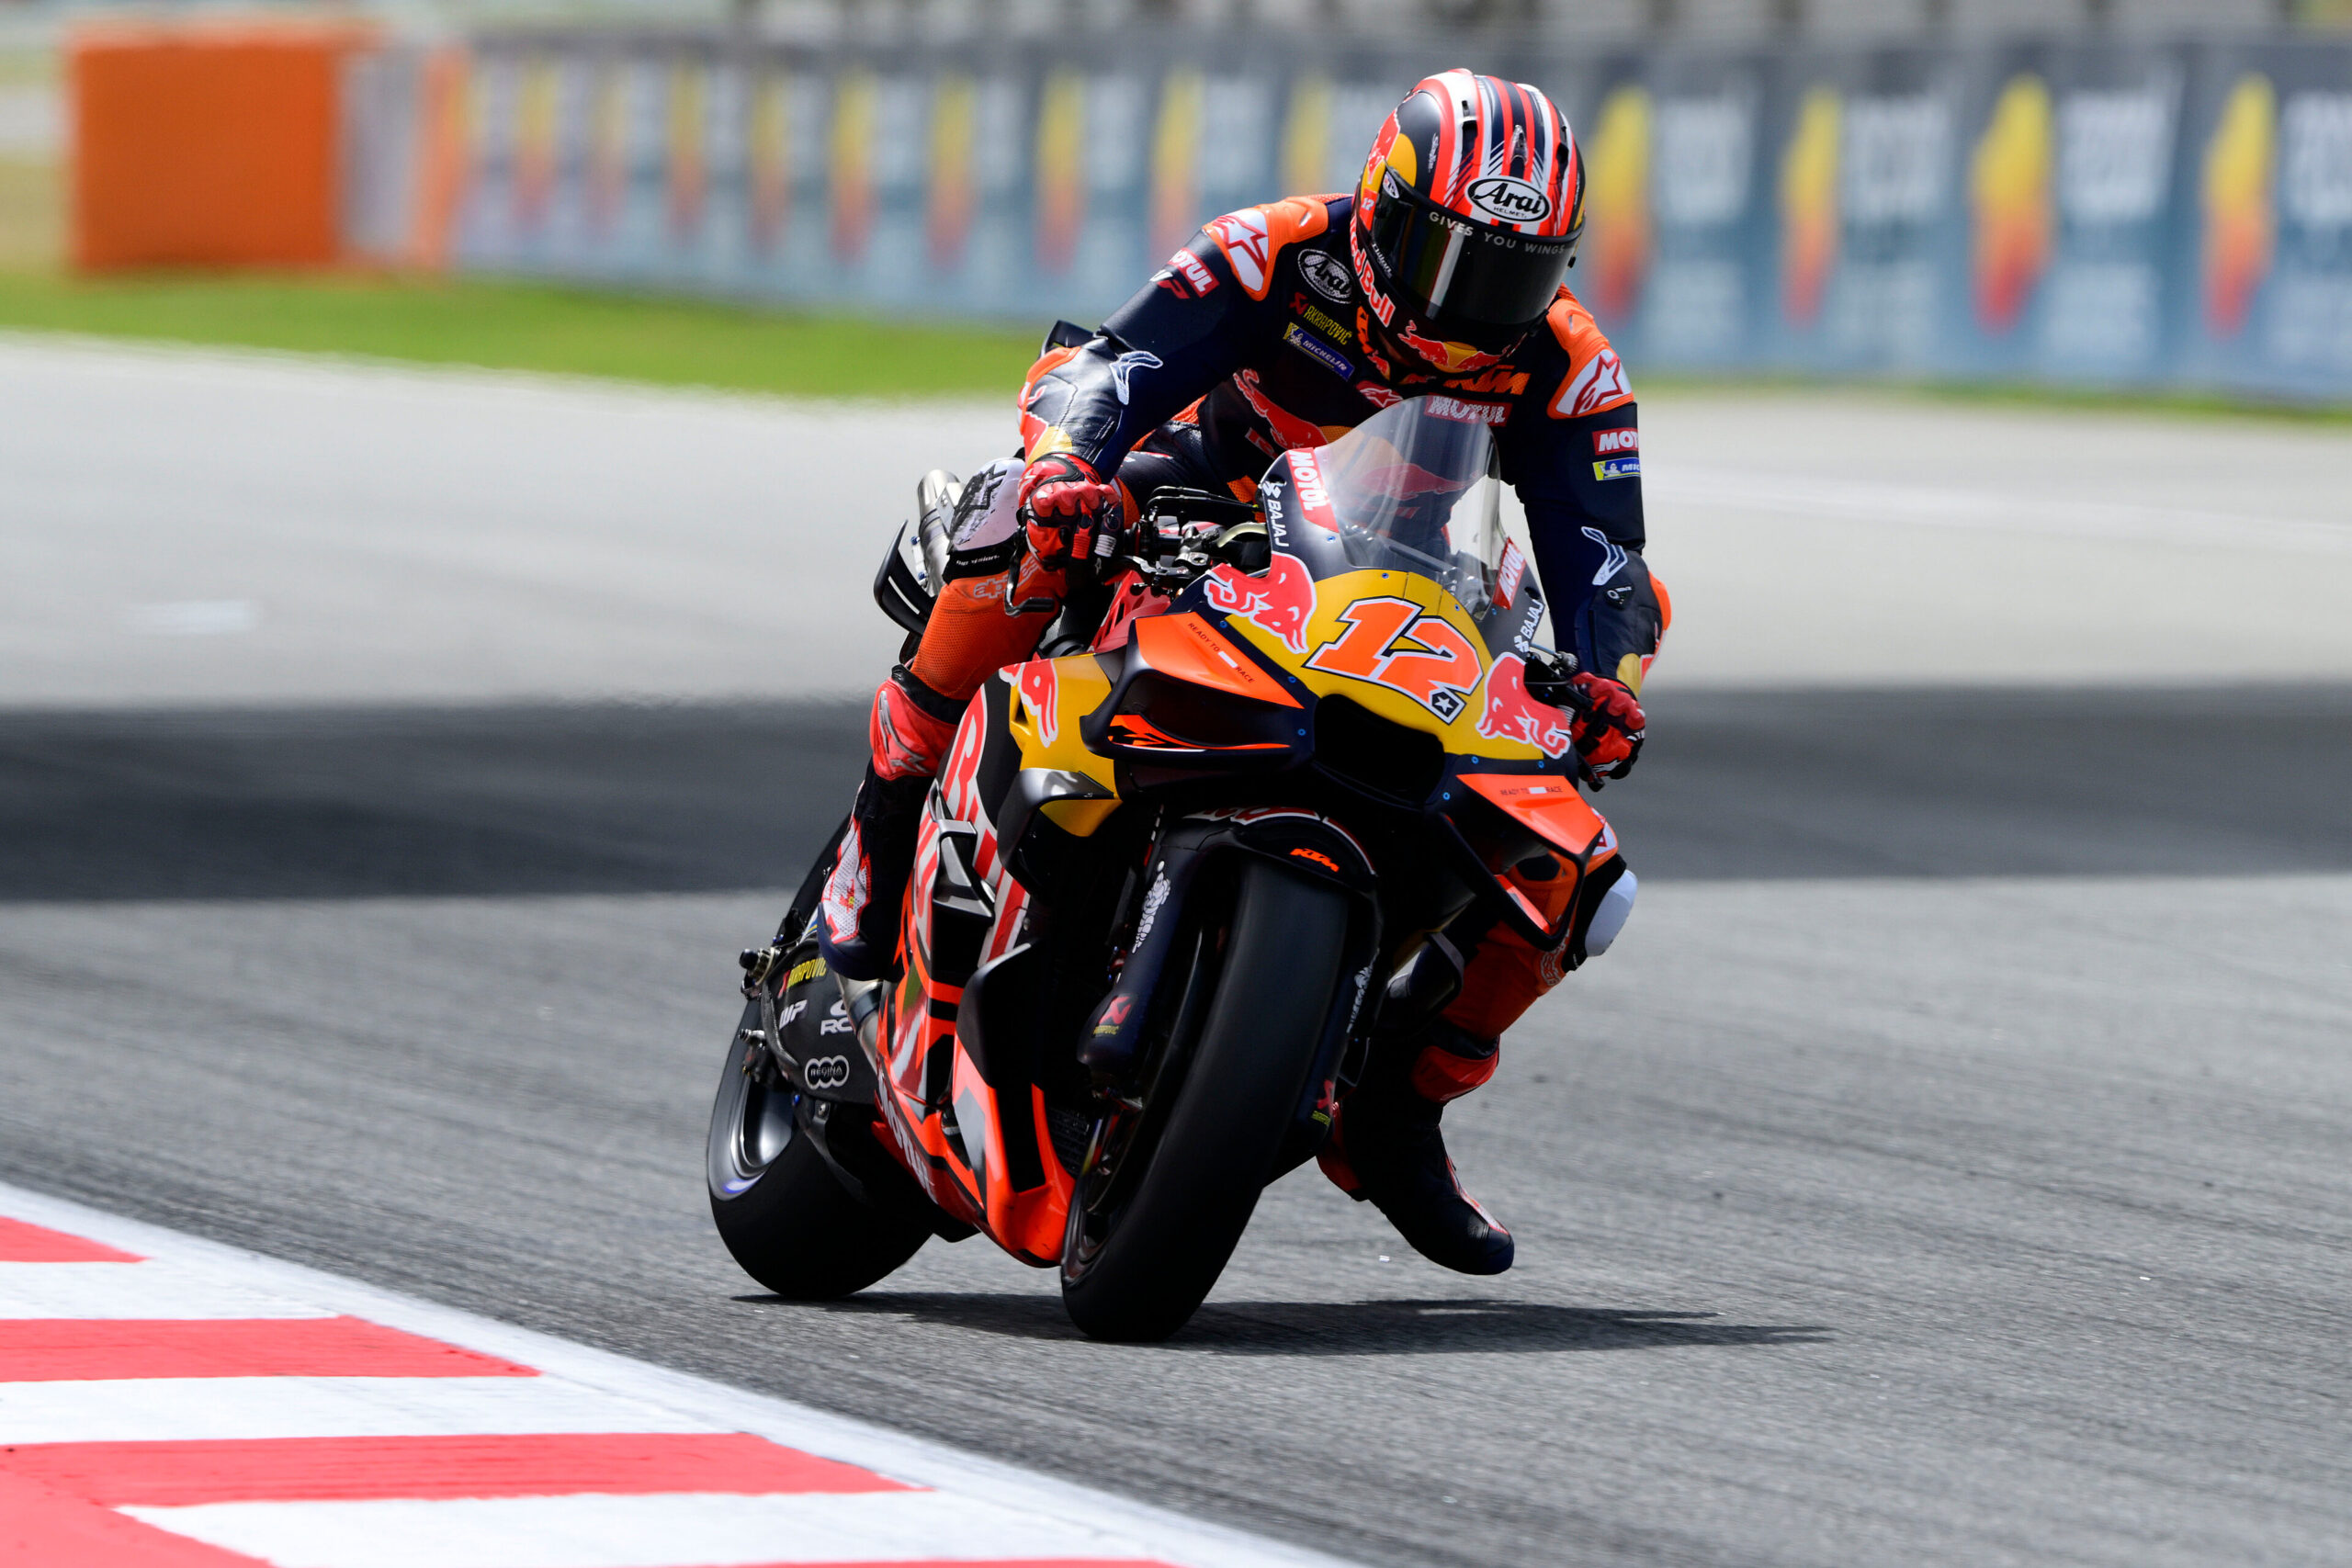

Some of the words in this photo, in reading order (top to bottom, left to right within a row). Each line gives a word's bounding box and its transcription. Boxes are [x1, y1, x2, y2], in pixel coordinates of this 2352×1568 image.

[1362, 197, 1374, 211] 12
[1472, 181, 1544, 215] Arai
[1493, 207, 1527, 219] HELMET
[1429, 211, 1474, 237] GIVES
[1484, 231, 1517, 250] YOU
[1524, 243, 1566, 254] WINGS
[1168, 249, 1216, 293] OTUL
[1303, 258, 1352, 295] Arai
[1360, 259, 1396, 328] Bull
[1303, 340, 1348, 371] MICHELIN
[1428, 395, 1507, 423] MOTUL
[1598, 431, 1639, 452] MOT
[1288, 450, 1329, 512] MOTUL
[1267, 499, 1289, 547] BAJAJ
[1498, 546, 1527, 601] MOTUL
[1520, 599, 1545, 640] BAJAJ
[1188, 623, 1210, 645] READY
[1209, 641, 1220, 653] TO
[1235, 666, 1255, 683] RACE
[1301, 595, 1485, 724] 12
[1545, 785, 1563, 794] RACE
[1290, 848, 1340, 873] KTM
[779, 999, 808, 1030] WP
[810, 1065, 842, 1077] REGINA
